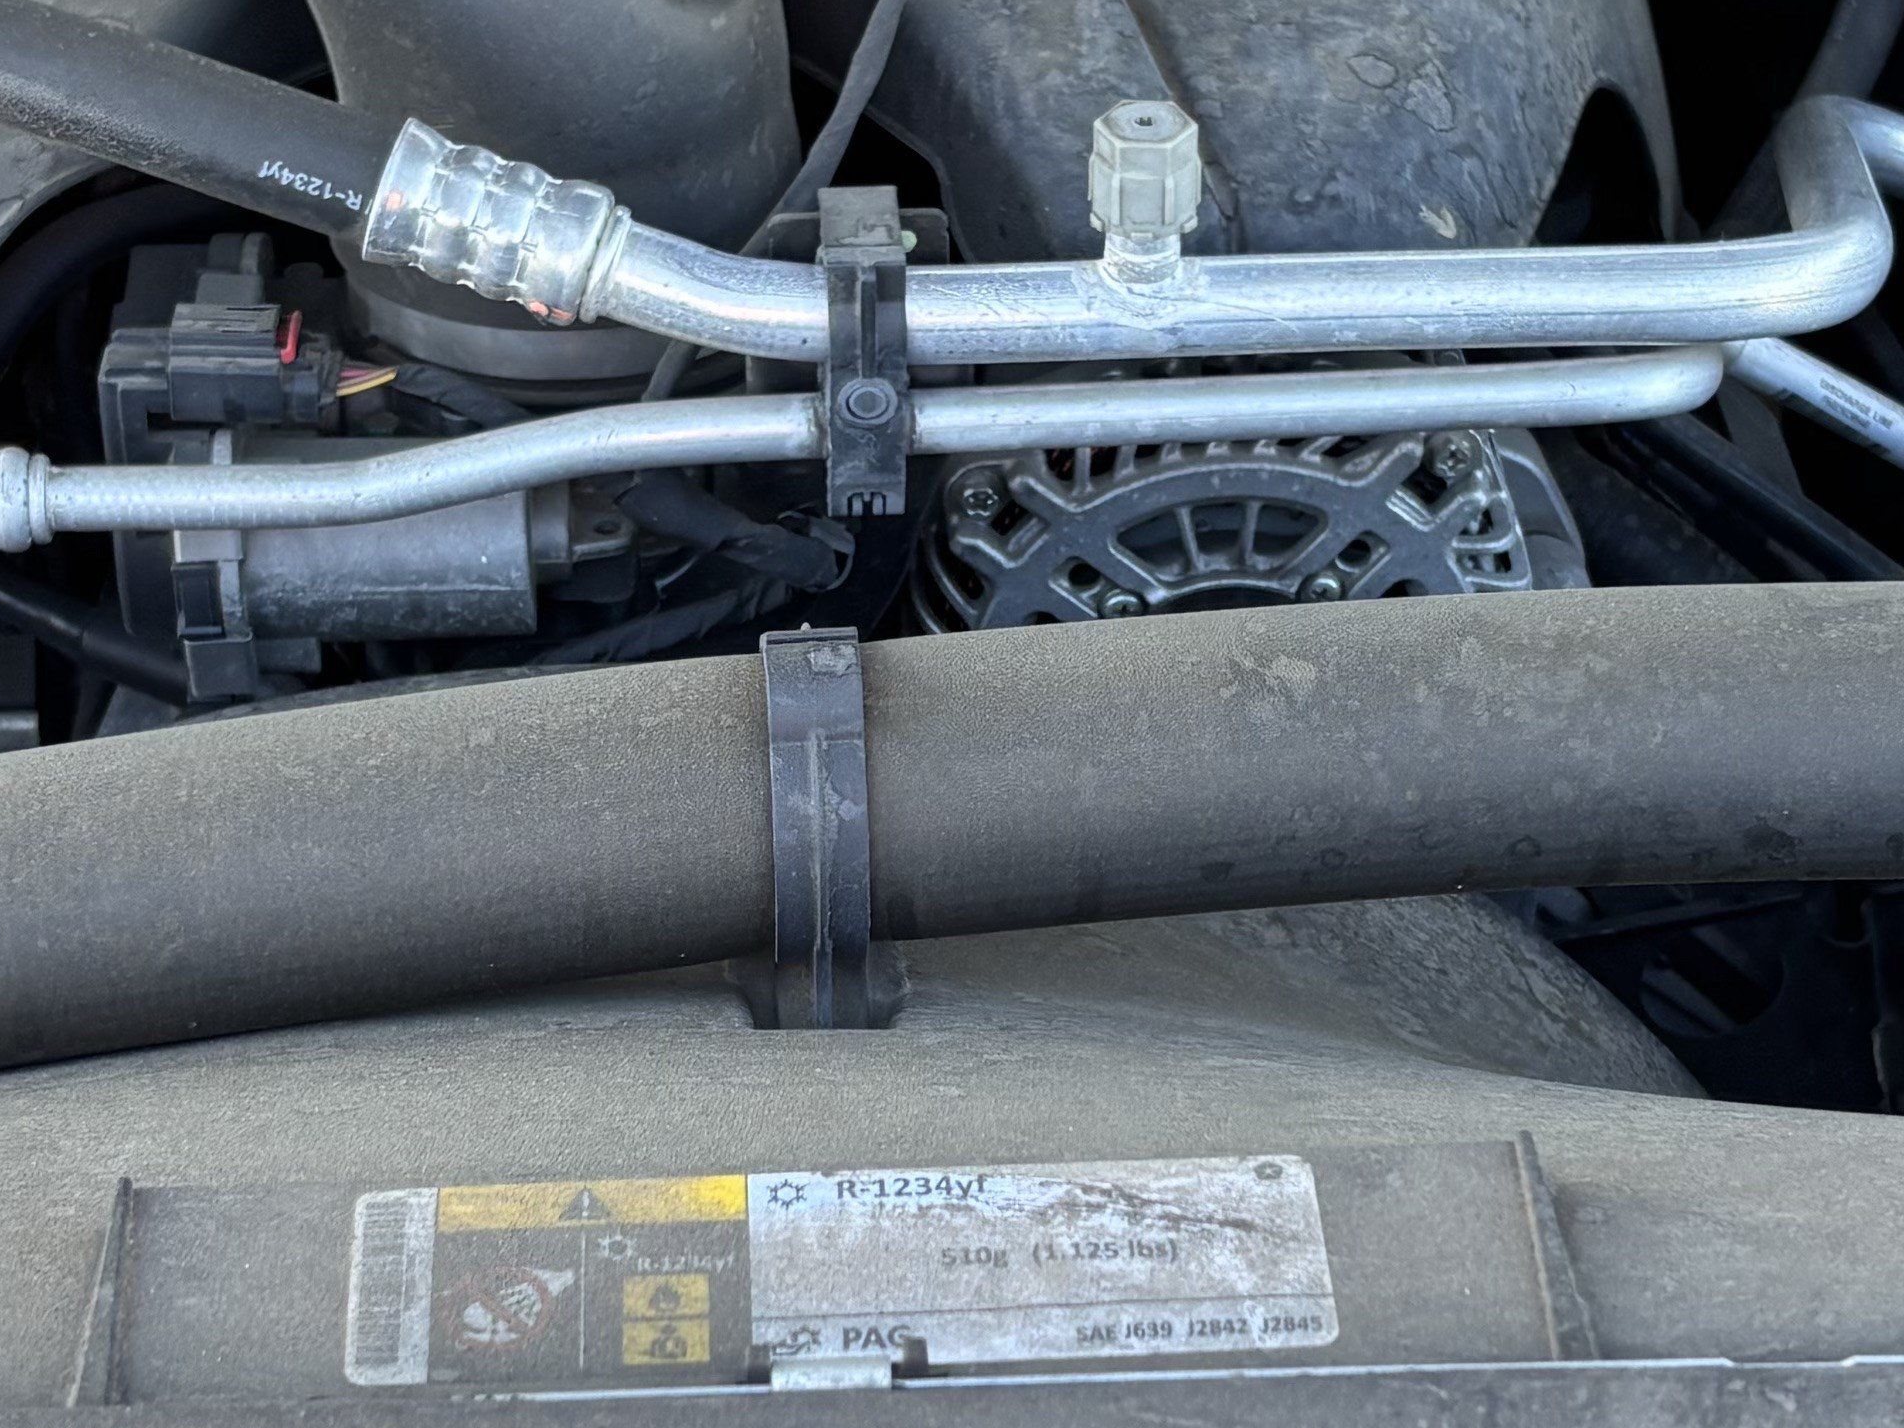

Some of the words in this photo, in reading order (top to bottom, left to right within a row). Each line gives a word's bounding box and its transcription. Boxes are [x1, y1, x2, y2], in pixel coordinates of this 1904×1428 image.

[257, 160, 363, 211] R-1234yf
[836, 1174, 988, 1202] R-1234yf
[941, 1245, 1008, 1269] 510g
[841, 1324, 911, 1351] PAG
[1075, 1323, 1118, 1344] SAE
